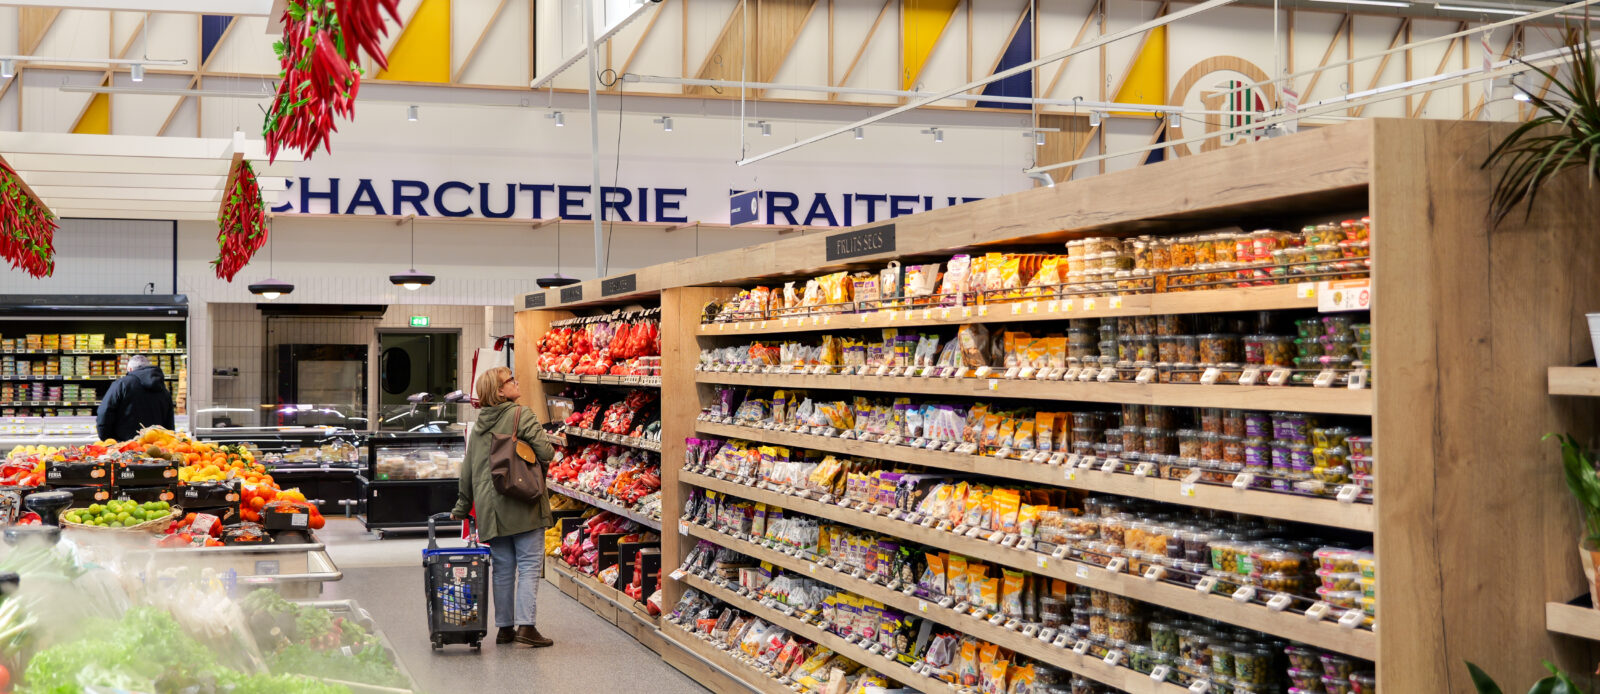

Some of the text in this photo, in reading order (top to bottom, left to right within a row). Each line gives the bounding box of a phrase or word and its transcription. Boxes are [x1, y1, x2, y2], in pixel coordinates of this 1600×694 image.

[730, 188, 986, 226] RAITE
[836, 232, 883, 255] FRUITS SECS
